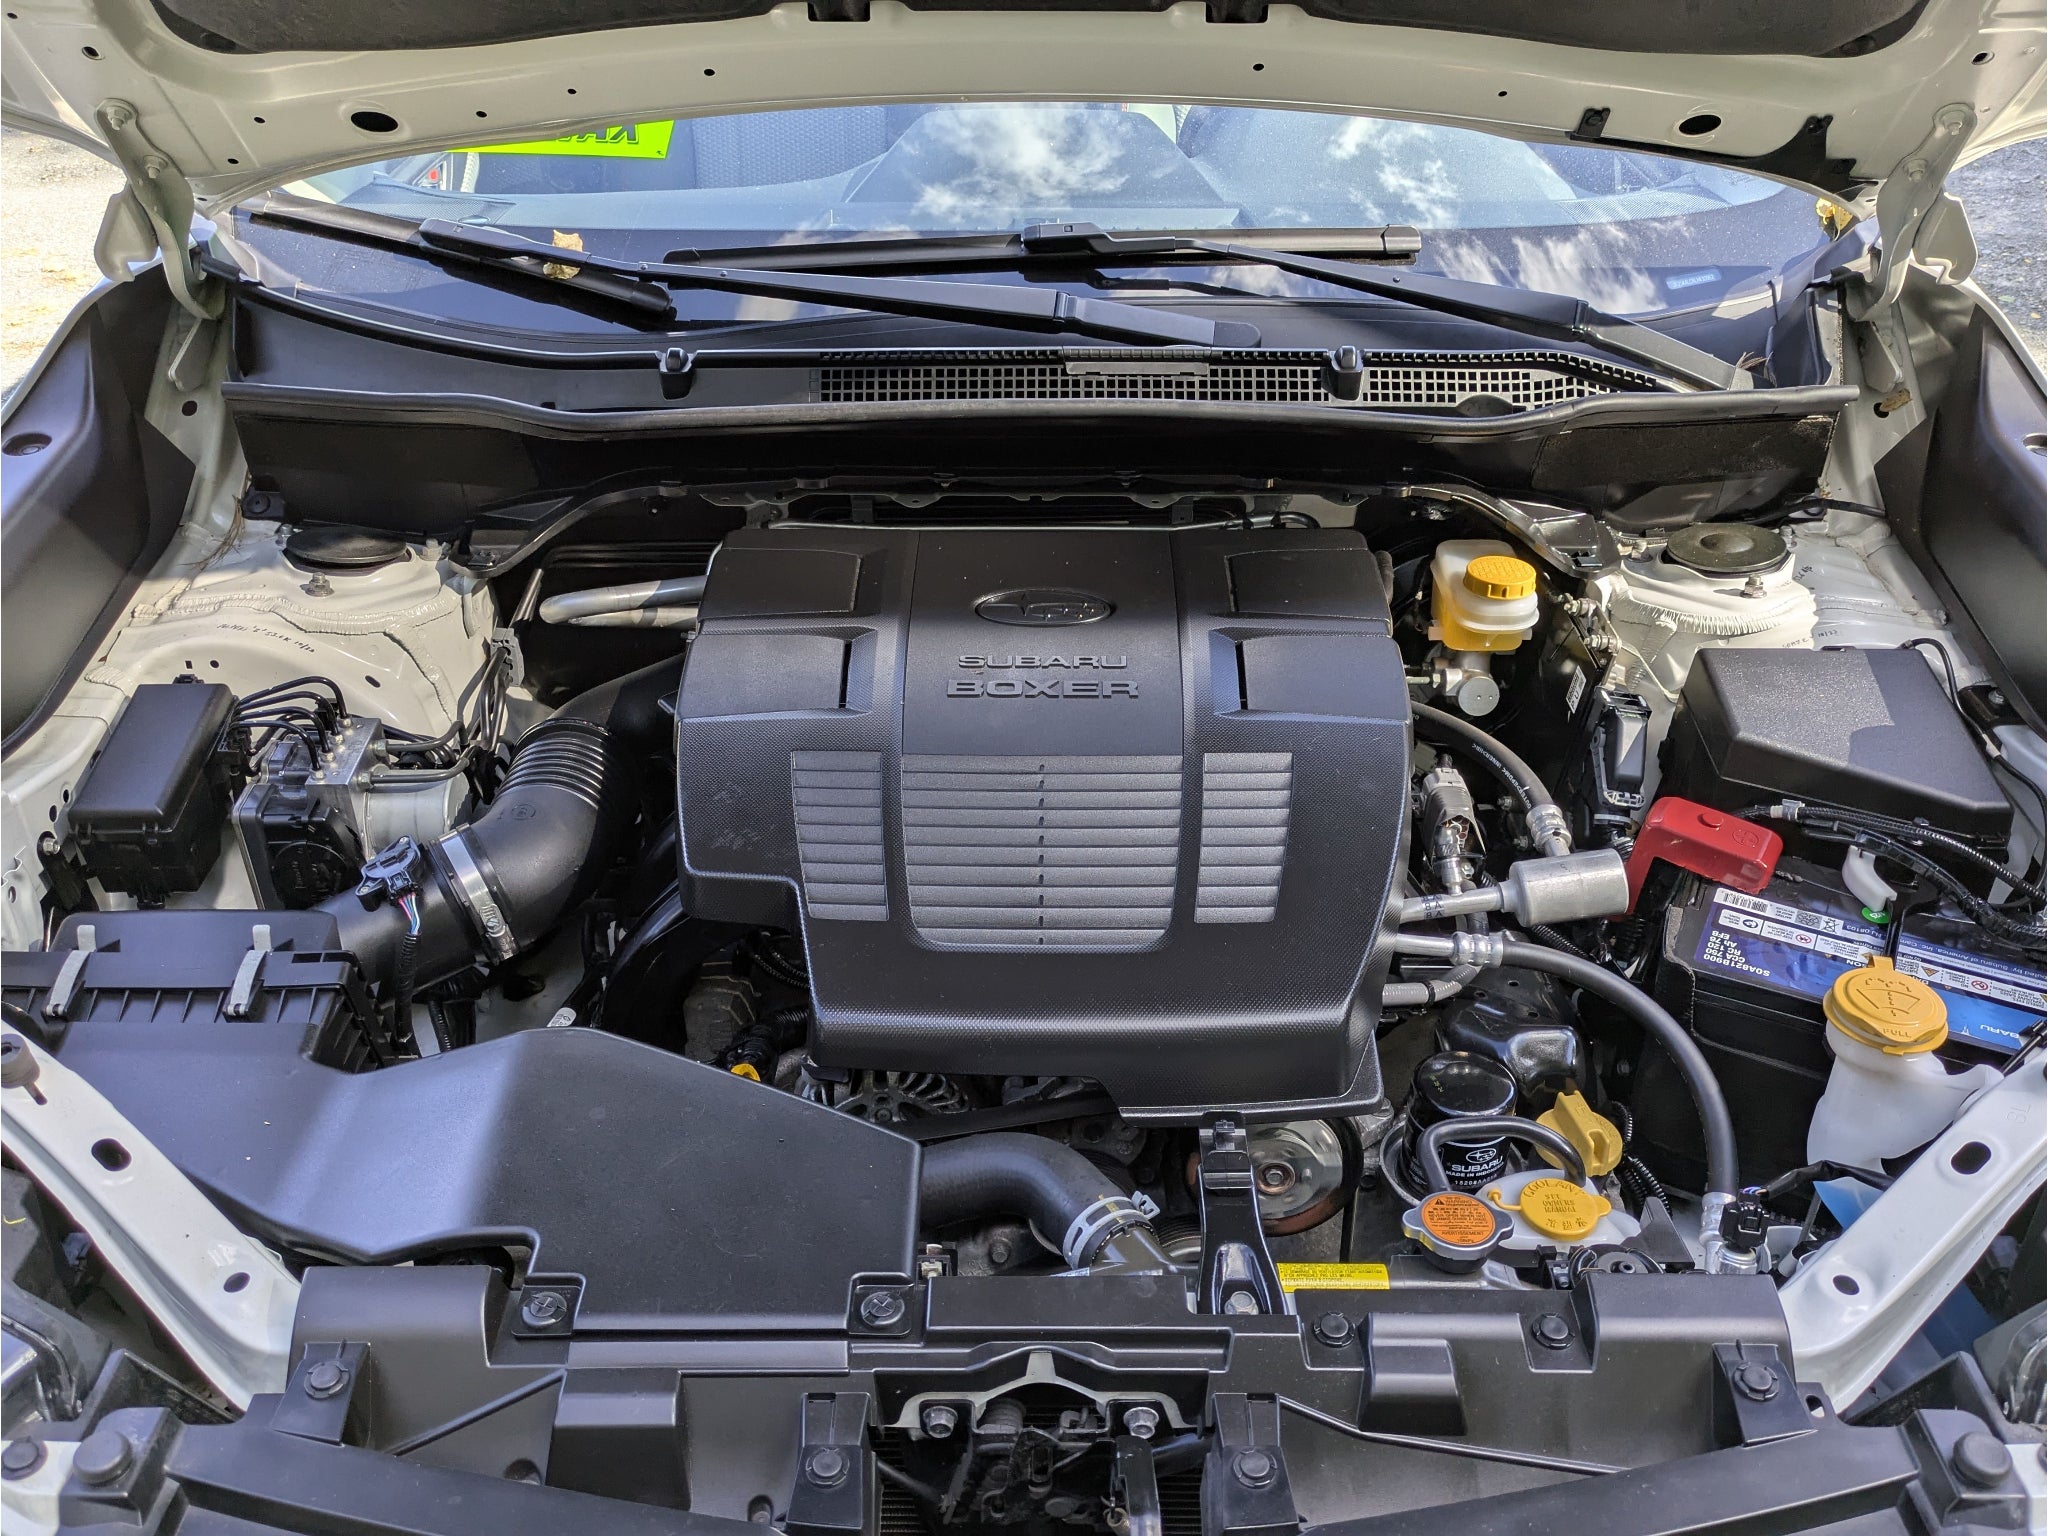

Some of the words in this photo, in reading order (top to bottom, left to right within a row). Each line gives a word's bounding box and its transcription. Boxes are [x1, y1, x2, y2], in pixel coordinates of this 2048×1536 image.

[958, 655, 1127, 669] SUBARU
[947, 680, 1139, 699] BOXER
[1711, 930, 1731, 940] EFB
[1707, 941, 1725, 950] 120
[1723, 939, 1738, 947] Ah
[1705, 947, 1723, 956] 750
[1726, 947, 1741, 956] RC
[1725, 953, 1745, 963] CCA
[1980, 959, 2008, 970] Subaru
[1979, 1023, 2019, 1038] BARU
[1451, 1156, 1503, 1172] SUBARU
